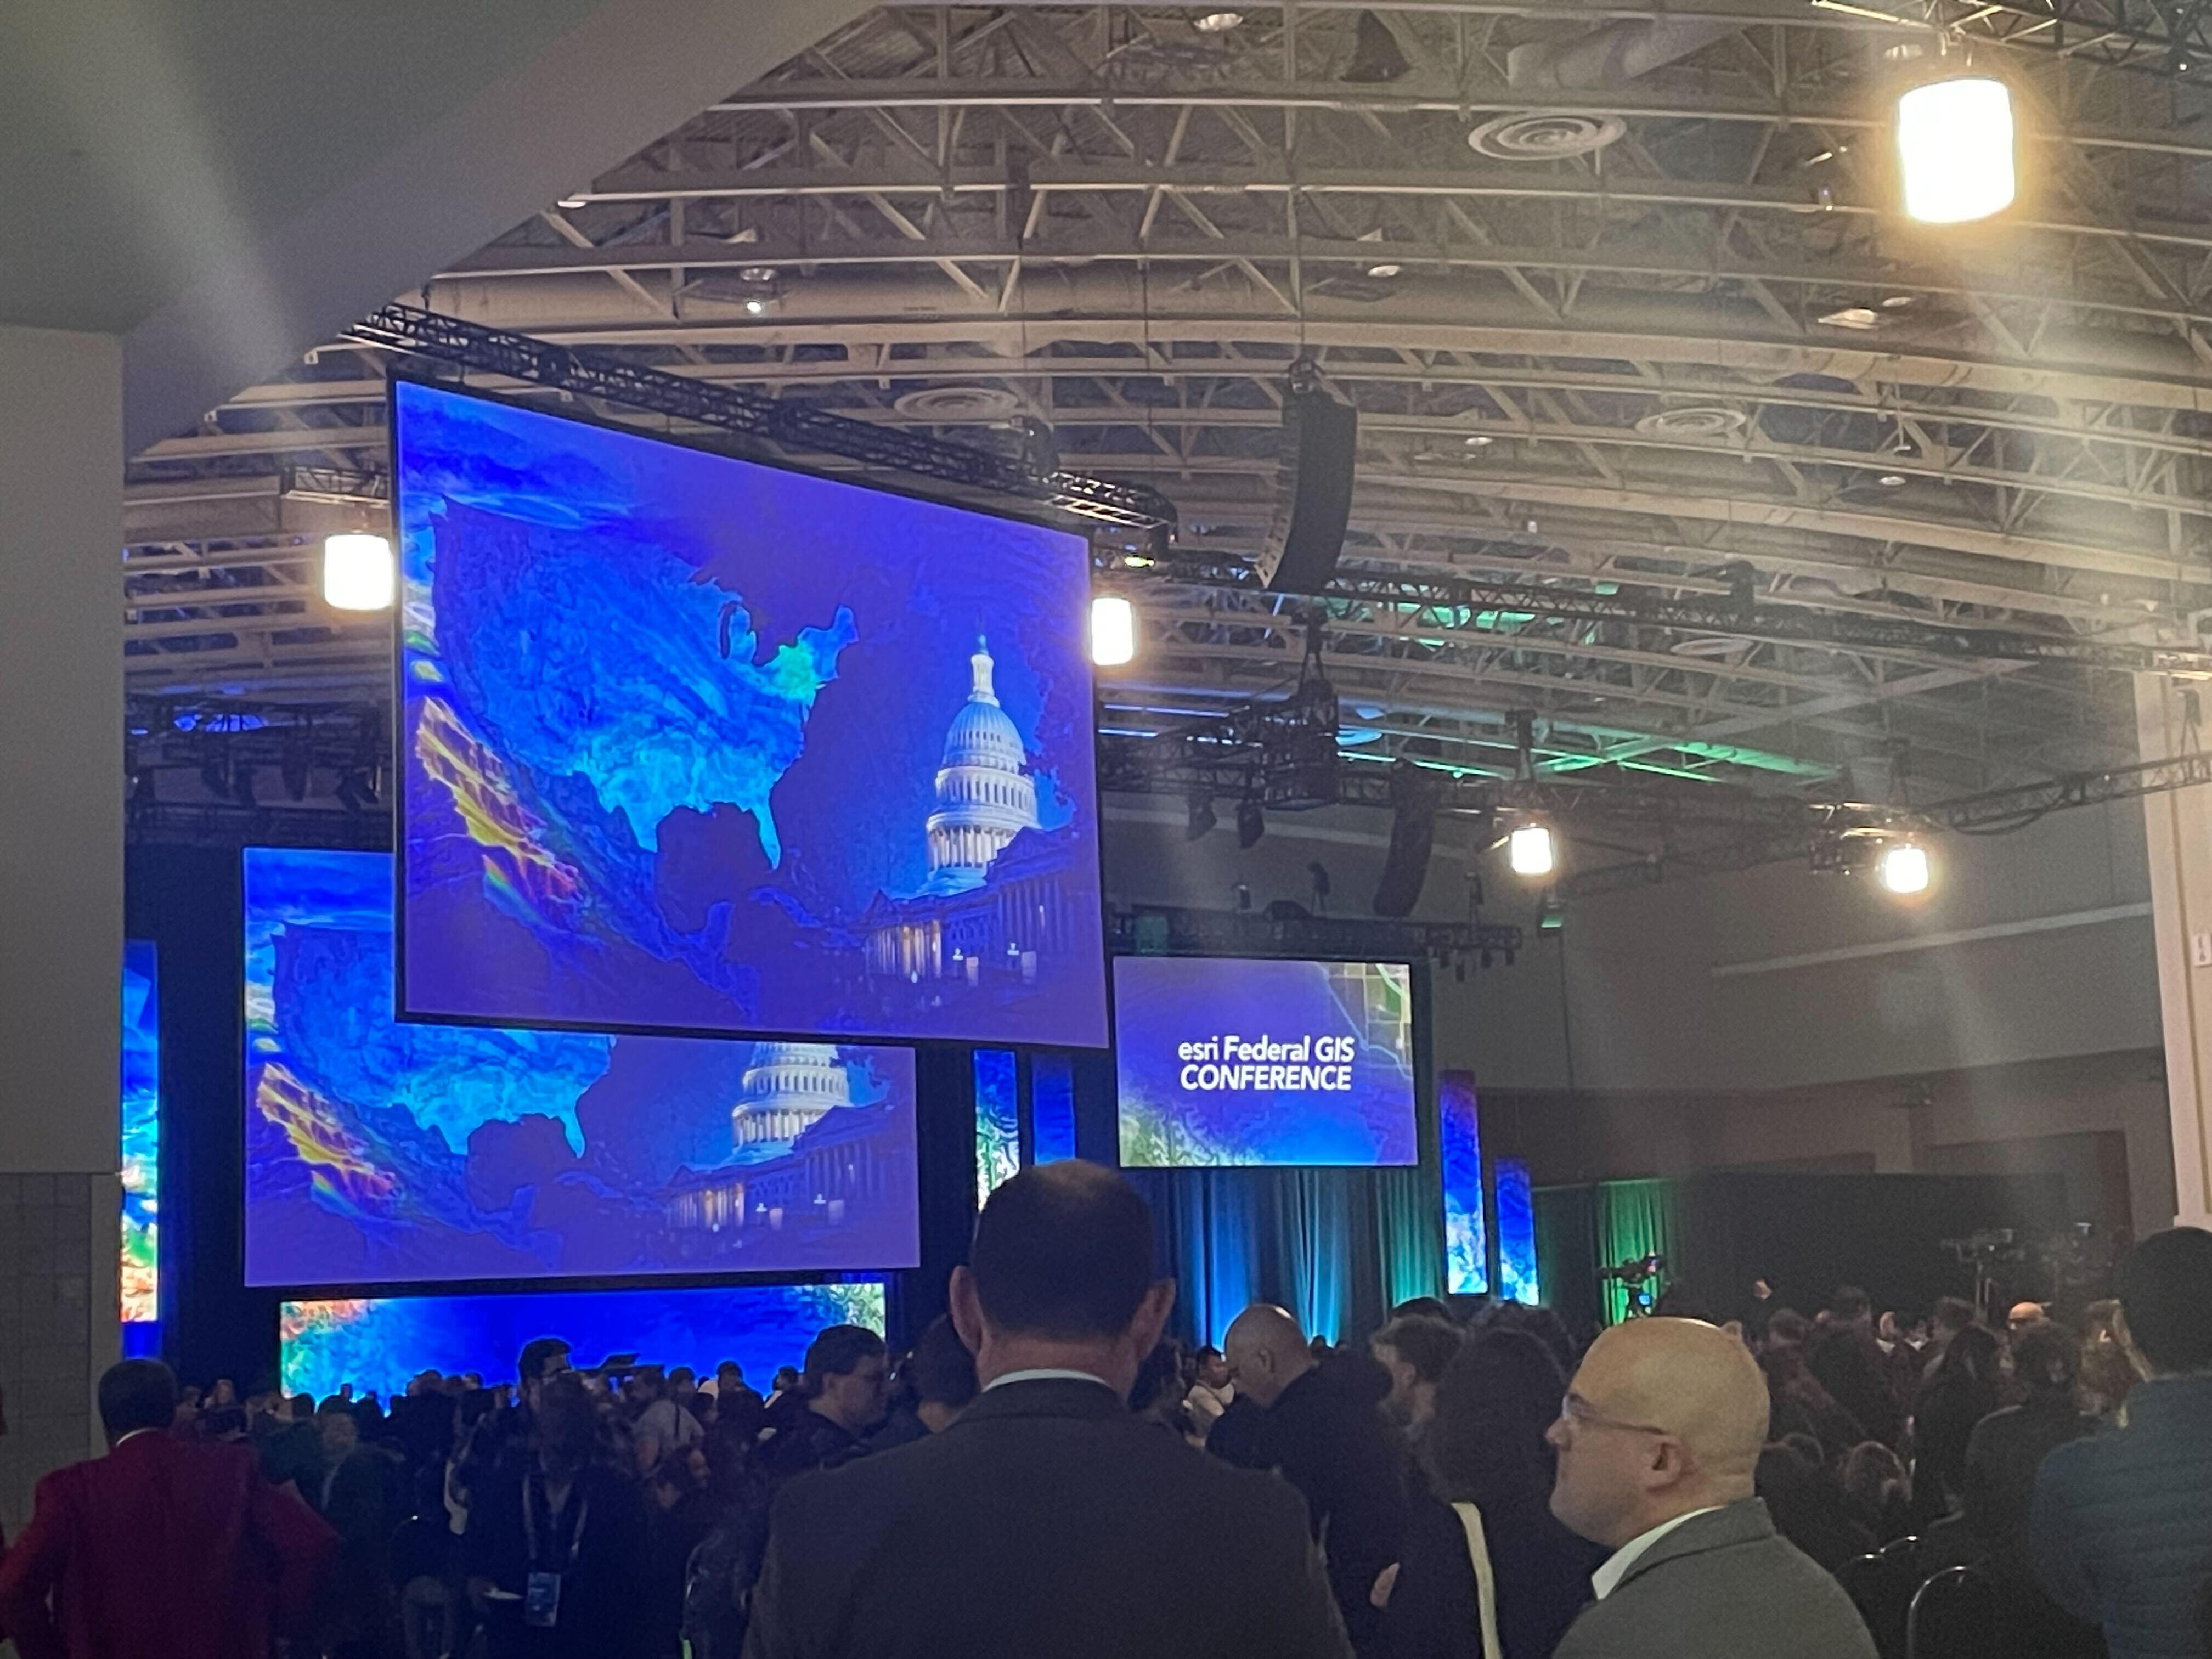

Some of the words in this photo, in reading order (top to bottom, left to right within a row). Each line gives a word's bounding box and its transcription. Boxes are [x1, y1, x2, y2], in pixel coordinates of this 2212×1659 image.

[1178, 1035, 1218, 1061] esri
[1224, 1034, 1310, 1062] Federal
[1315, 1036, 1355, 1062] GIS
[1180, 1064, 1352, 1091] CONFERENCE
